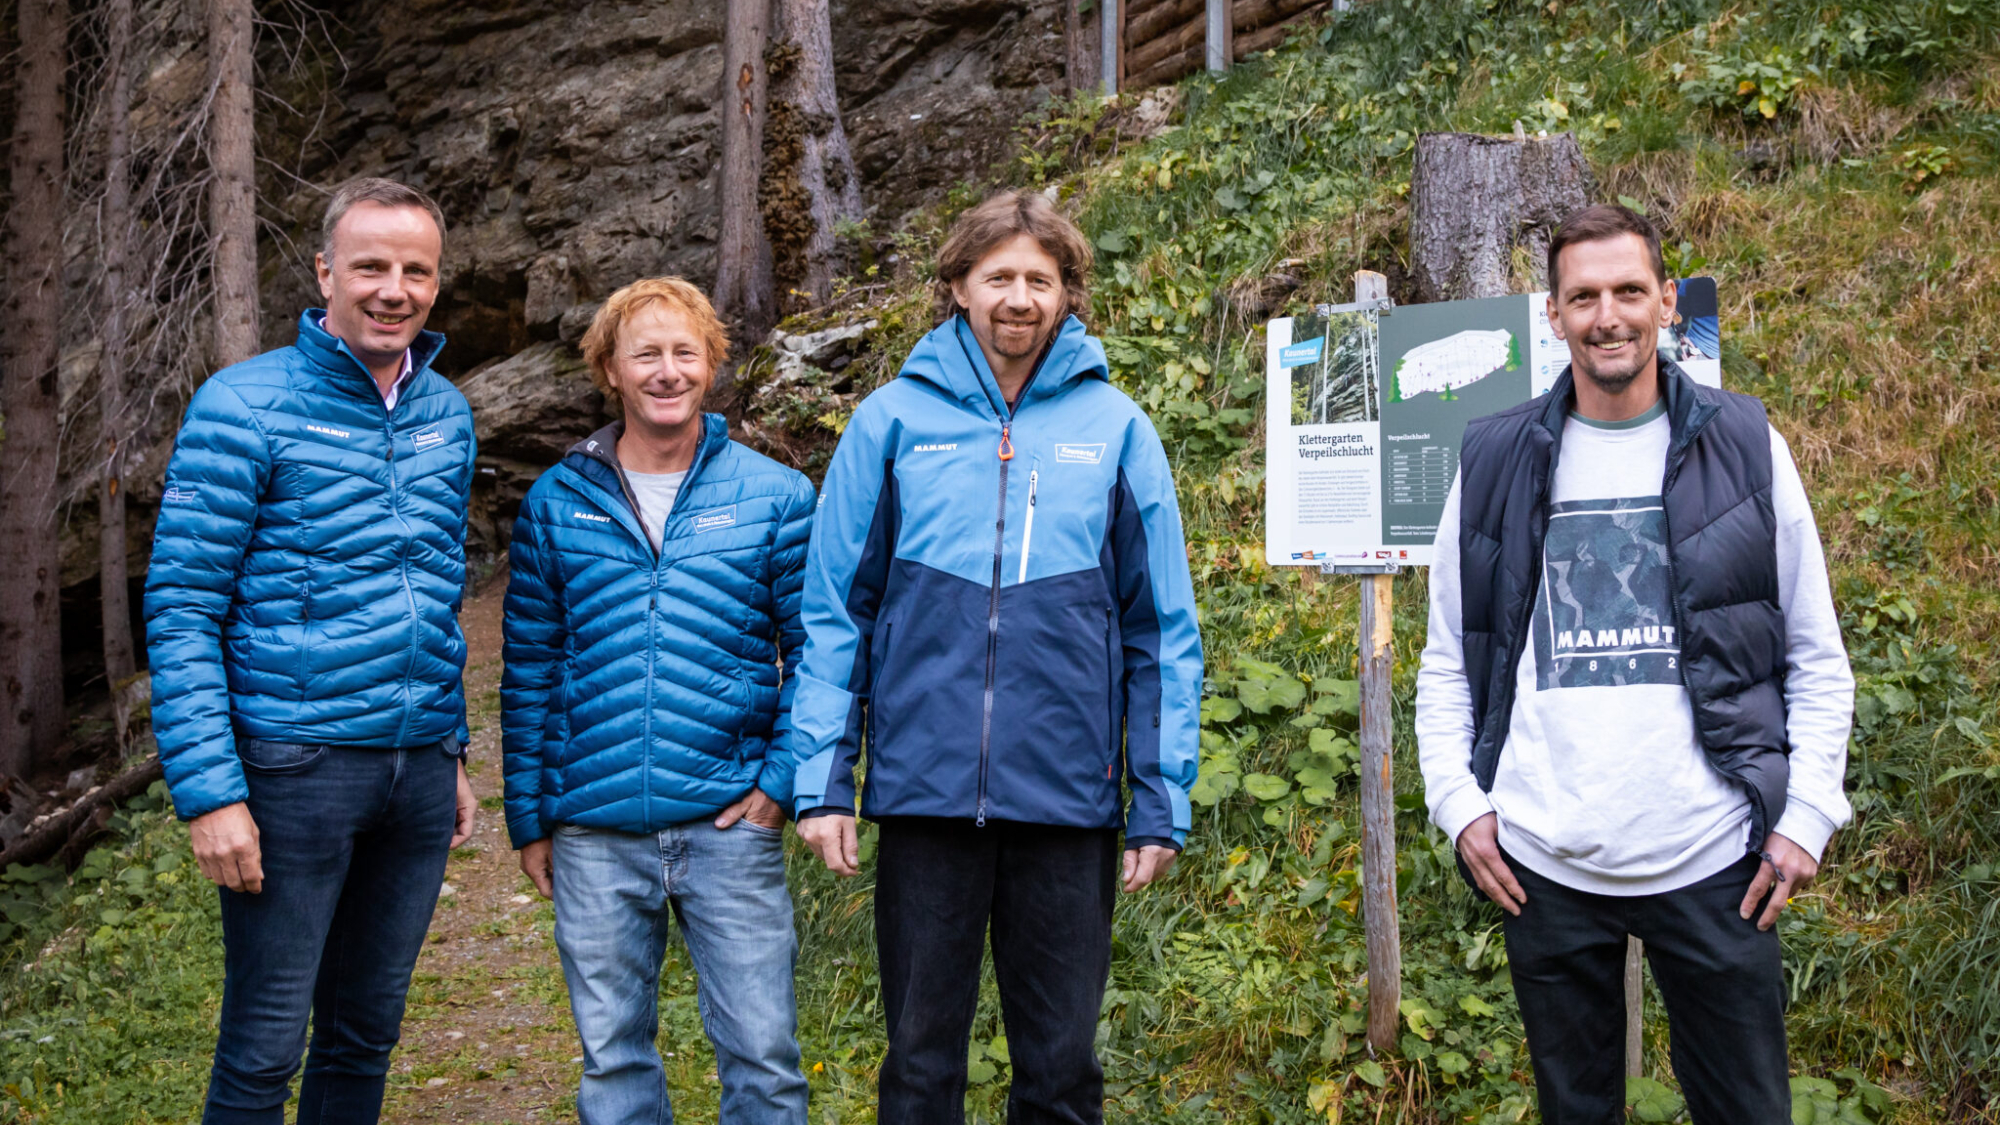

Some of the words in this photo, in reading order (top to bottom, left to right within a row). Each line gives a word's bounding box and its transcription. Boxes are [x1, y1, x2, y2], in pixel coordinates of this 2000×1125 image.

[307, 424, 350, 438] MAMMUT
[1299, 434, 1363, 446] Klettergarten
[1387, 433, 1431, 442] Verpeilschlucht
[914, 444, 958, 452] MAMMUT
[1299, 445, 1374, 460] Verpeilschlucht
[574, 512, 611, 523] MAMMUT
[698, 513, 731, 524] Kaunertal
[1557, 626, 1676, 649] MAMMUT
